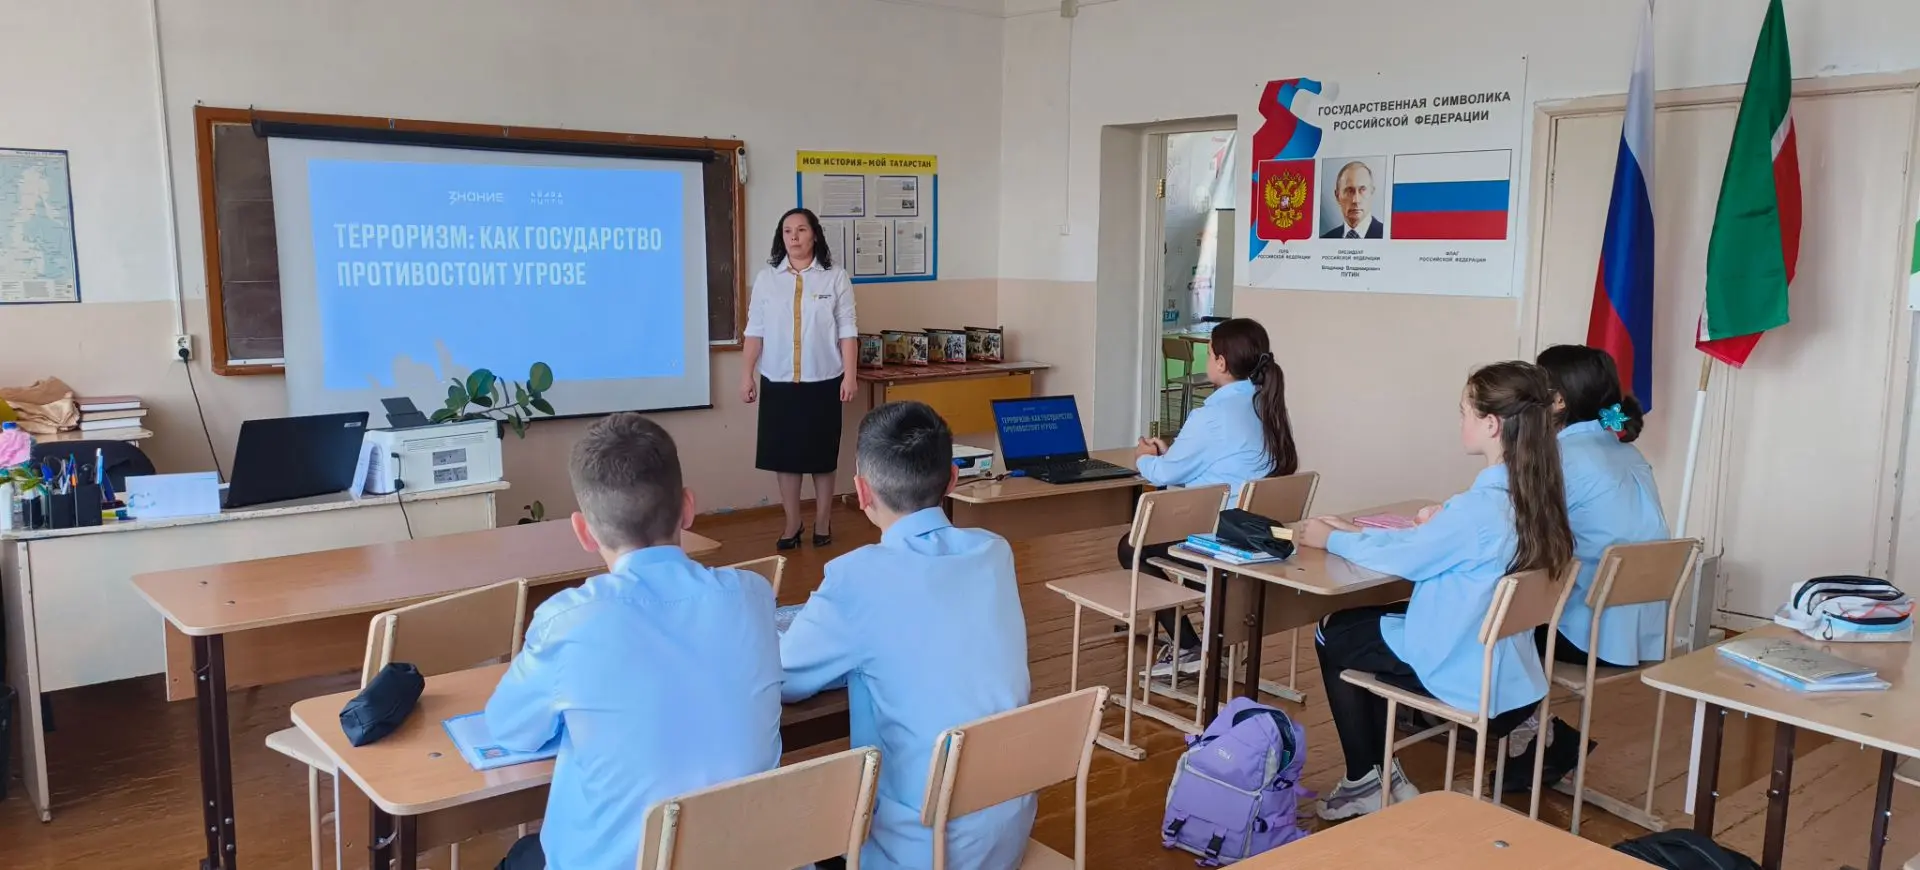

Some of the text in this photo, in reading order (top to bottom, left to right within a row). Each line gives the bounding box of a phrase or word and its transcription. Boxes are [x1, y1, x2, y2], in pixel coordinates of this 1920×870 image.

[1318, 91, 1511, 117] ГОСУДАРСТВЕННАЯ СИМВОЛИКА
[1333, 110, 1489, 131] РОССИЙСКОЙ ФЕДЕРАЦИИ
[802, 157, 821, 165] МОЯ
[890, 159, 932, 168] ТАТАРСТАН
[333, 222, 662, 254] ТЕРРОРИЗМ: КАК ГОСУДАРСТВО
[337, 261, 587, 287] ПРОТИВОСТОИТ УГРОЗЕ
